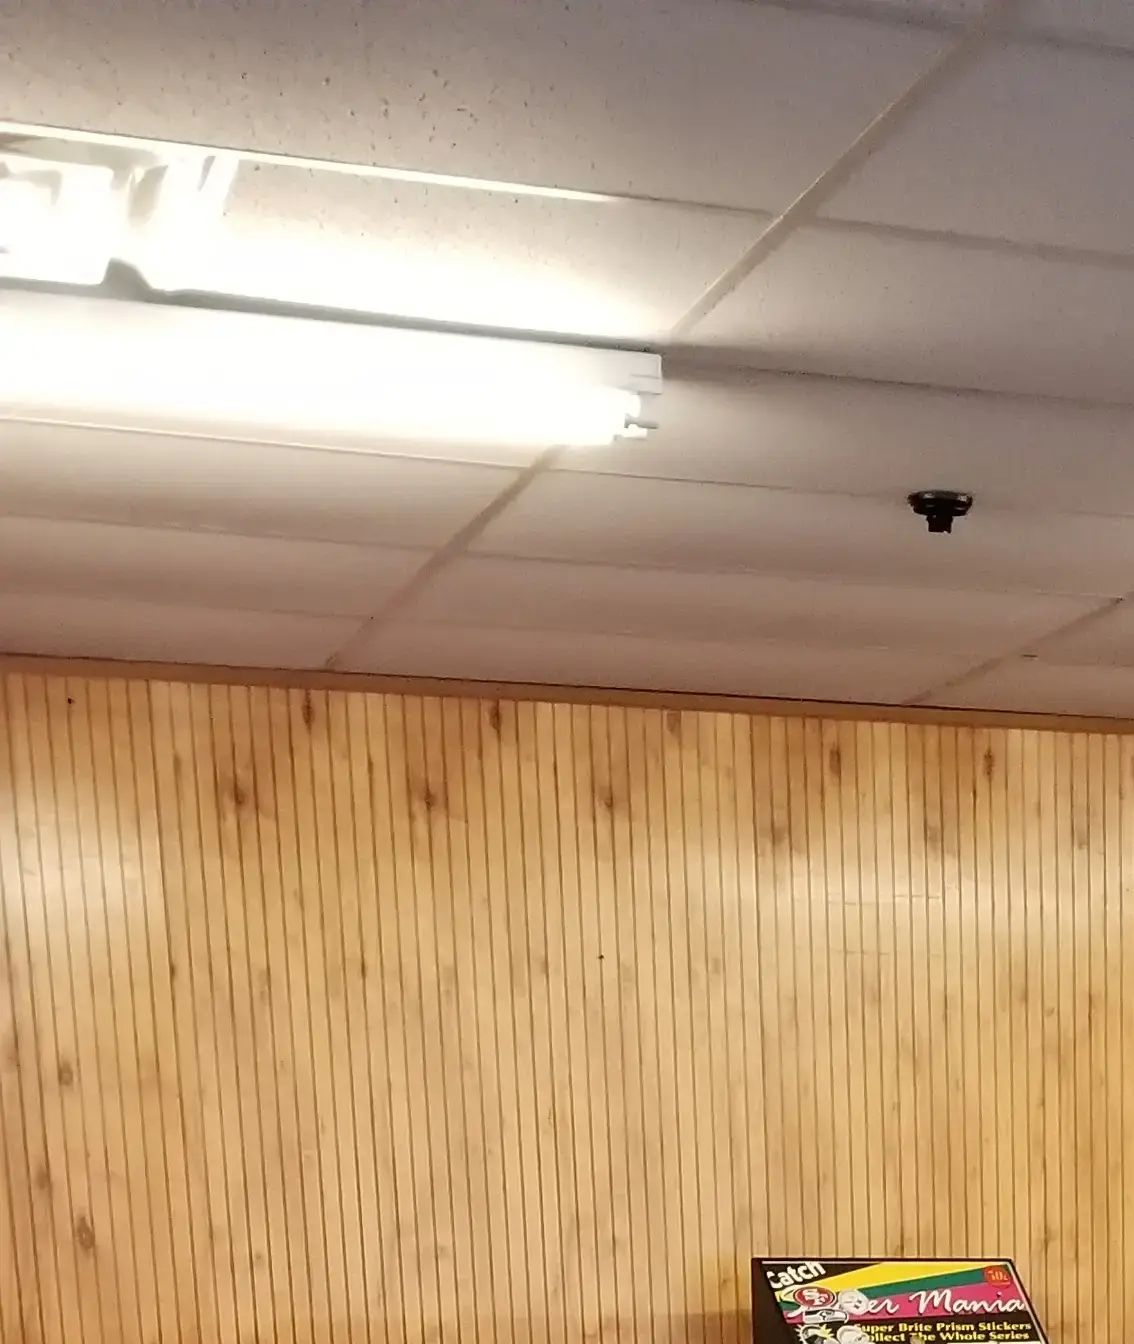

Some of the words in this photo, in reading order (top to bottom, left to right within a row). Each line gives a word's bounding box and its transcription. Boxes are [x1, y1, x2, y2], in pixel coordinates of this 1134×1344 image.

[766, 1261, 826, 1289] Catch
[909, 1288, 1025, 1314] Mania
[898, 1322, 932, 1332] Brite
[936, 1321, 974, 1332] Prism
[979, 1321, 1031, 1331] Stickers
[868, 1332, 905, 1342] ollect
[939, 1331, 985, 1341] Whole
[990, 1331, 1029, 1340] Series
